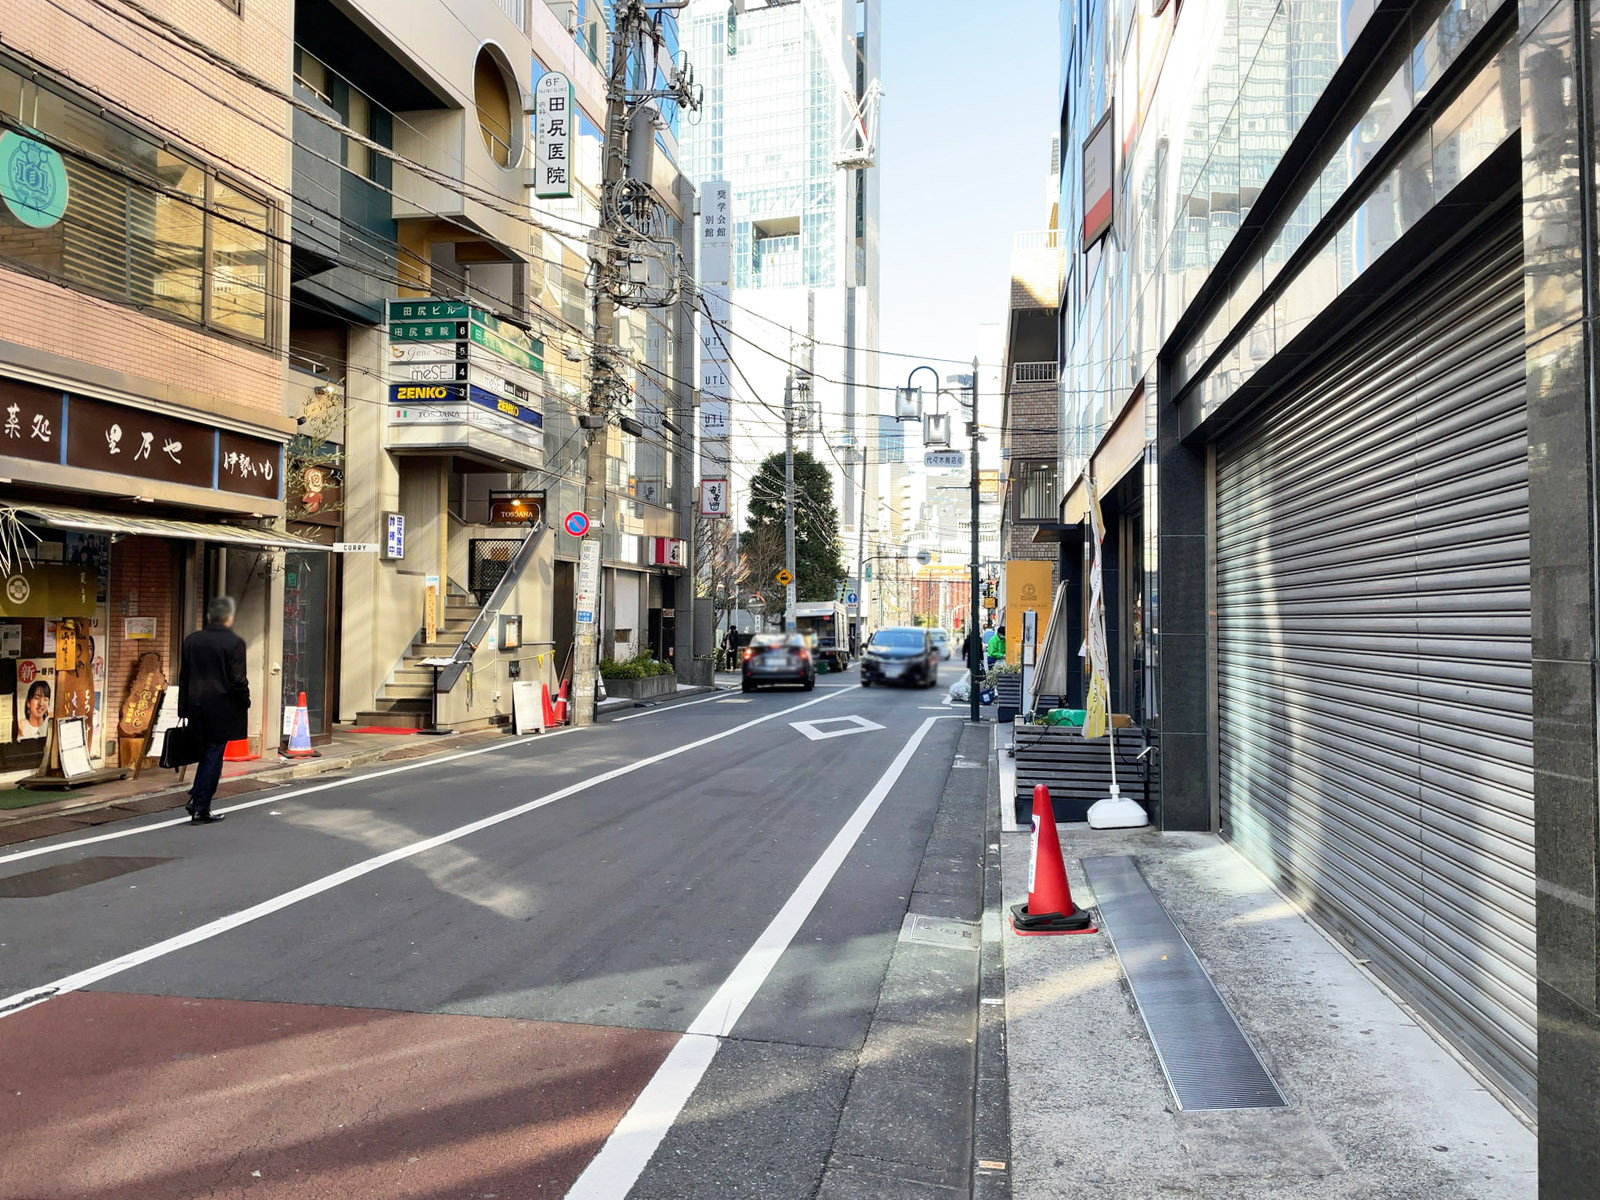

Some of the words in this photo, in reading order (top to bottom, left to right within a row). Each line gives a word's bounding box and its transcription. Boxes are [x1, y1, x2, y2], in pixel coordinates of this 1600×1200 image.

[545, 77, 560, 87] 6F
[546, 96, 567, 185] 田尻医院
[704, 214, 715, 238] 別館
[402, 305, 457, 316] 田尻ビル
[394, 326, 450, 338] 田尻医院
[459, 326, 466, 335] 6
[459, 347, 466, 356] 5
[459, 367, 466, 376] 4
[397, 386, 447, 399] ZENKO
[497, 399, 519, 417] ZENKO
[223, 450, 275, 481] 伊勢いも
[343, 544, 367, 552] CURRY
[20, 664, 35, 682] 新
